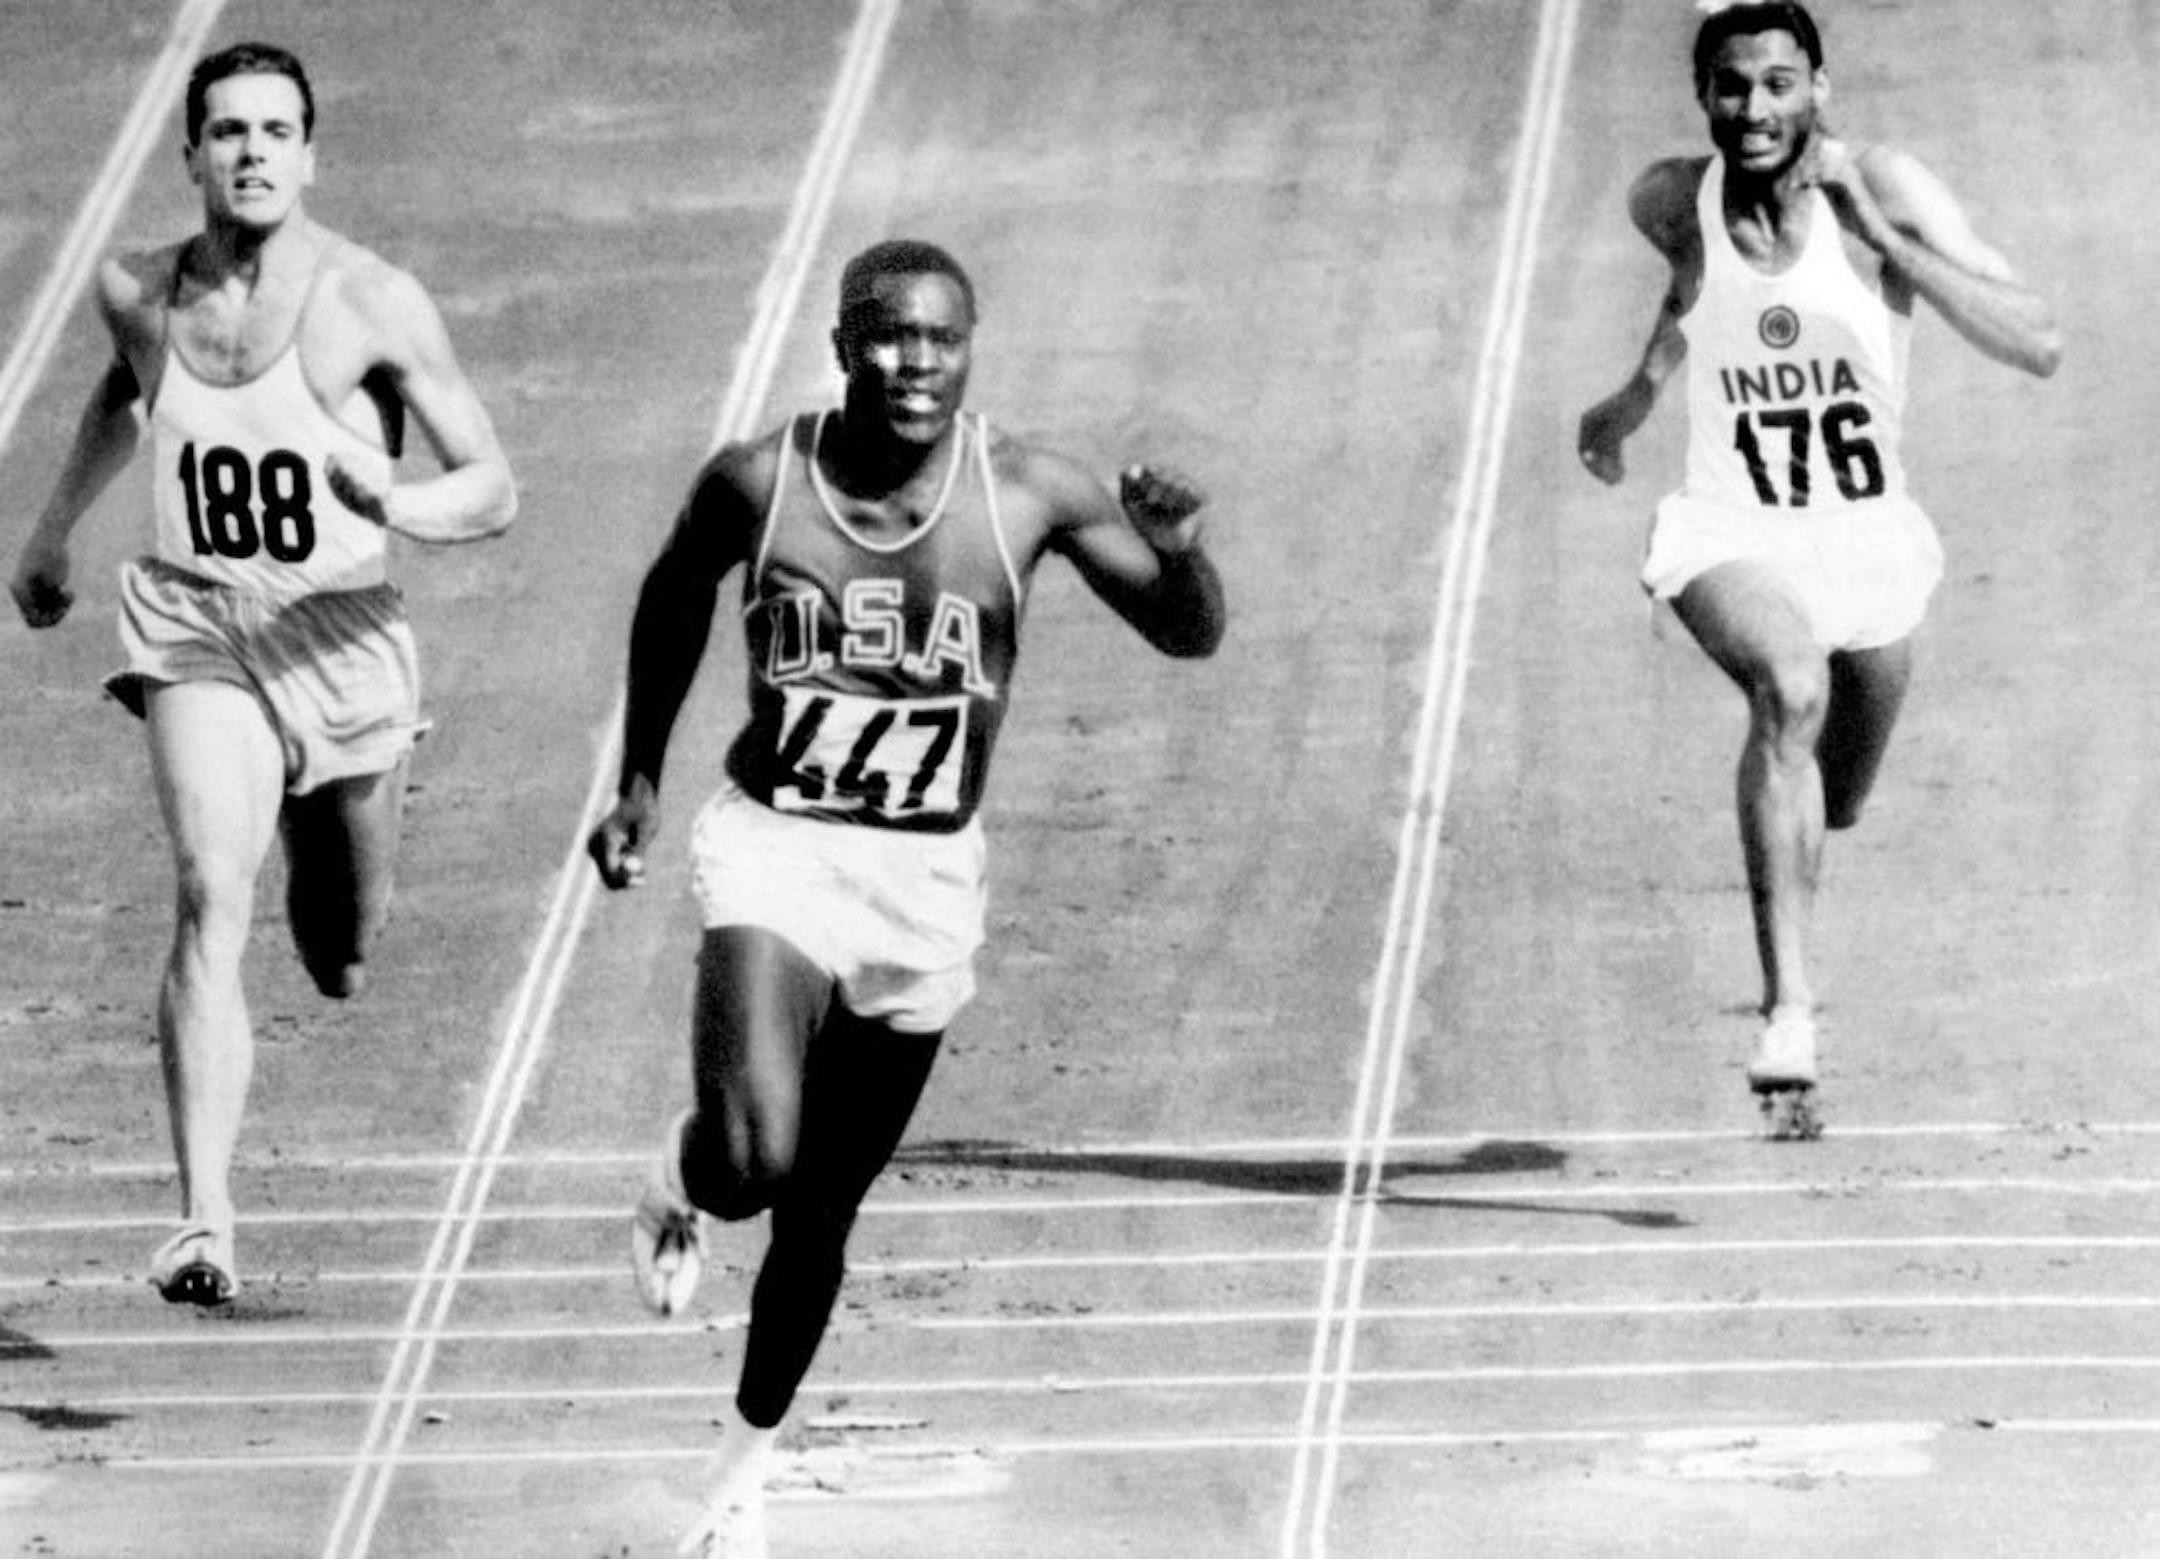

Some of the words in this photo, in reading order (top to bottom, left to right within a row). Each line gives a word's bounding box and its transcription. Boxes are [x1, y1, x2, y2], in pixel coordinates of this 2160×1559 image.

[1720, 358, 1860, 404] INDIA
[178, 441, 316, 562] 188
[1734, 401, 1885, 507] 176
[776, 698, 960, 808] 447
